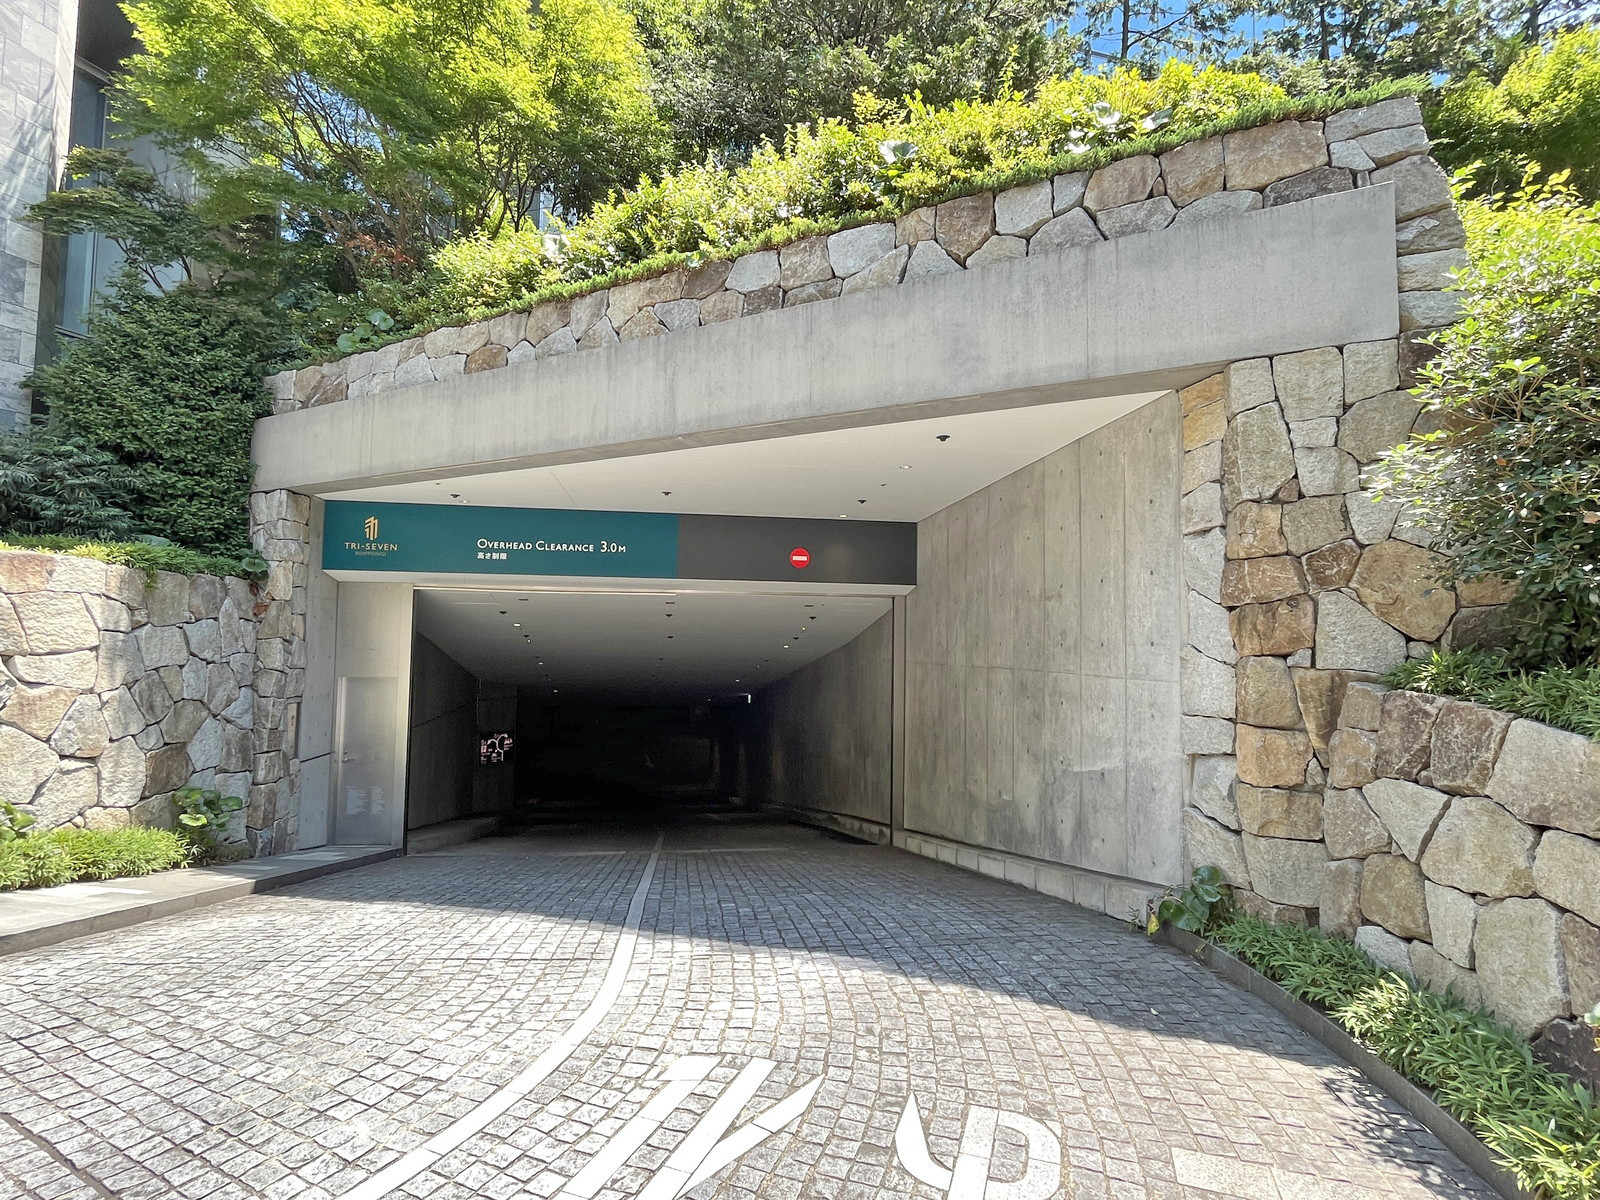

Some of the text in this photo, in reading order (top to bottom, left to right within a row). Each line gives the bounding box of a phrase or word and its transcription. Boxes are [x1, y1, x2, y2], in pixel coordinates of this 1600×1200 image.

[345, 541, 398, 551] TRI-SEVEN
[476, 552, 508, 561] 高さ制限
